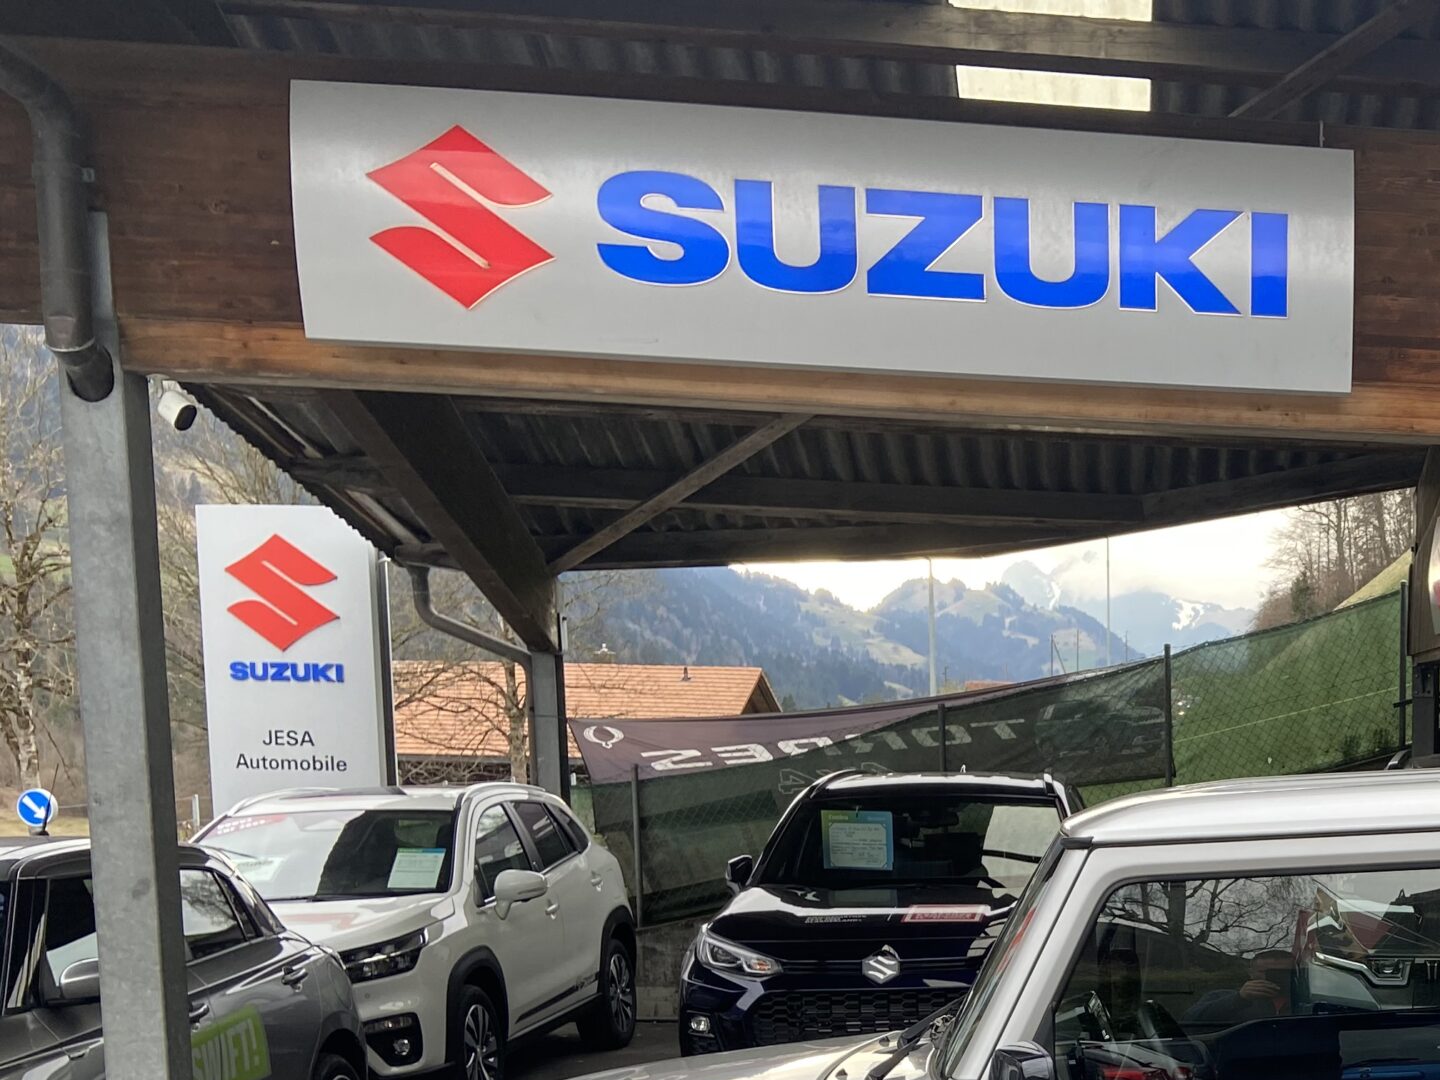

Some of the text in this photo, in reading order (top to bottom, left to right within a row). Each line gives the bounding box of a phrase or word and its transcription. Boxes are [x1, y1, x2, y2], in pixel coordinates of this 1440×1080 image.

[596, 169, 1290, 318] SUZUKI
[229, 660, 345, 683] SUZUKI
[262, 730, 315, 747] JESA
[236, 752, 347, 772] Automobile
